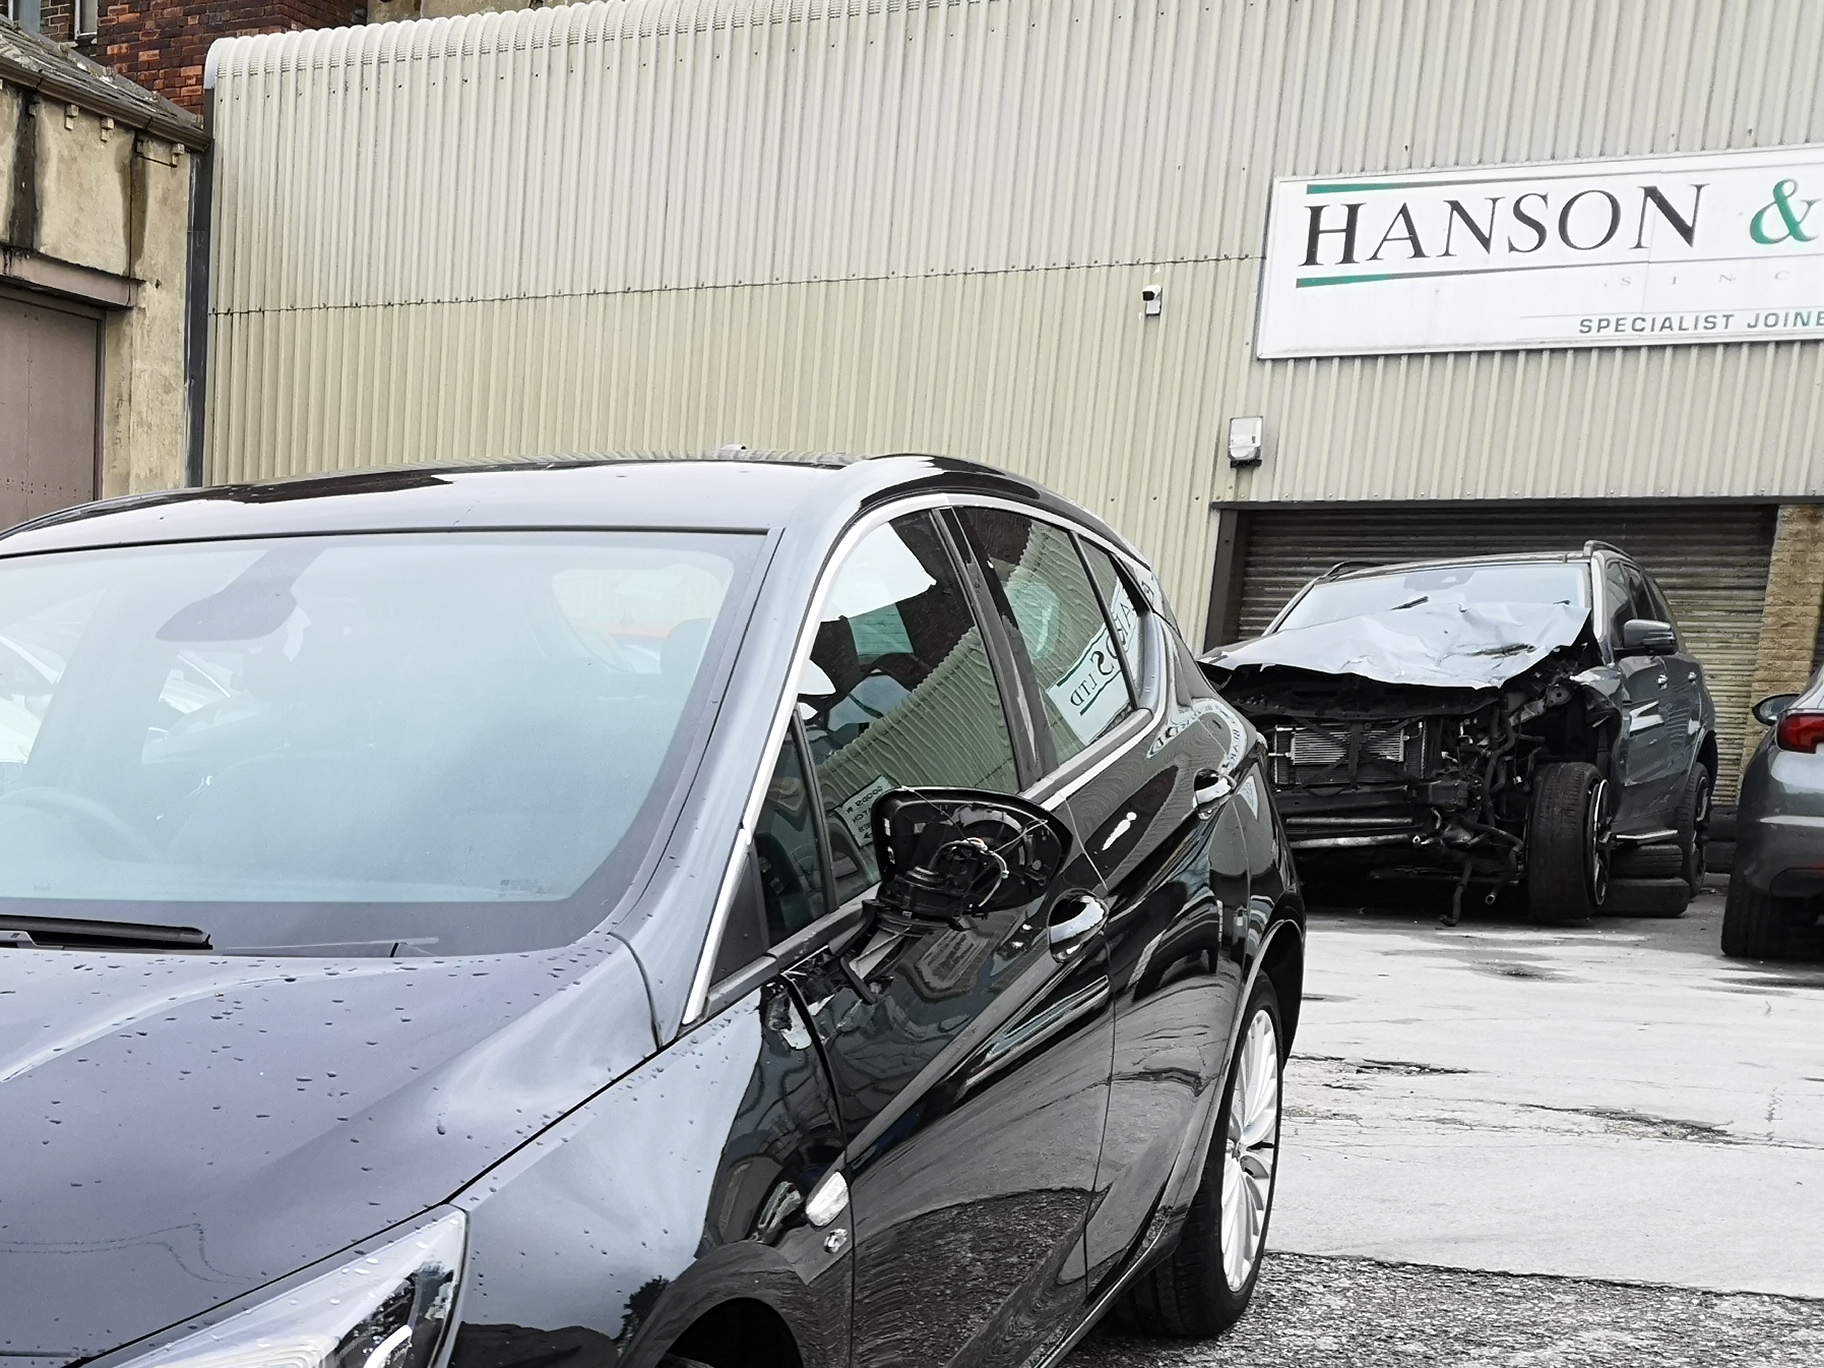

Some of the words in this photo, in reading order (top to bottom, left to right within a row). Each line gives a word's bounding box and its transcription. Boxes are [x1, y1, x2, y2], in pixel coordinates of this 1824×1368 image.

[1298, 184, 1706, 267] HANSON
[1749, 178, 1822, 245] &
[1578, 313, 1735, 334] SPECIALIST
